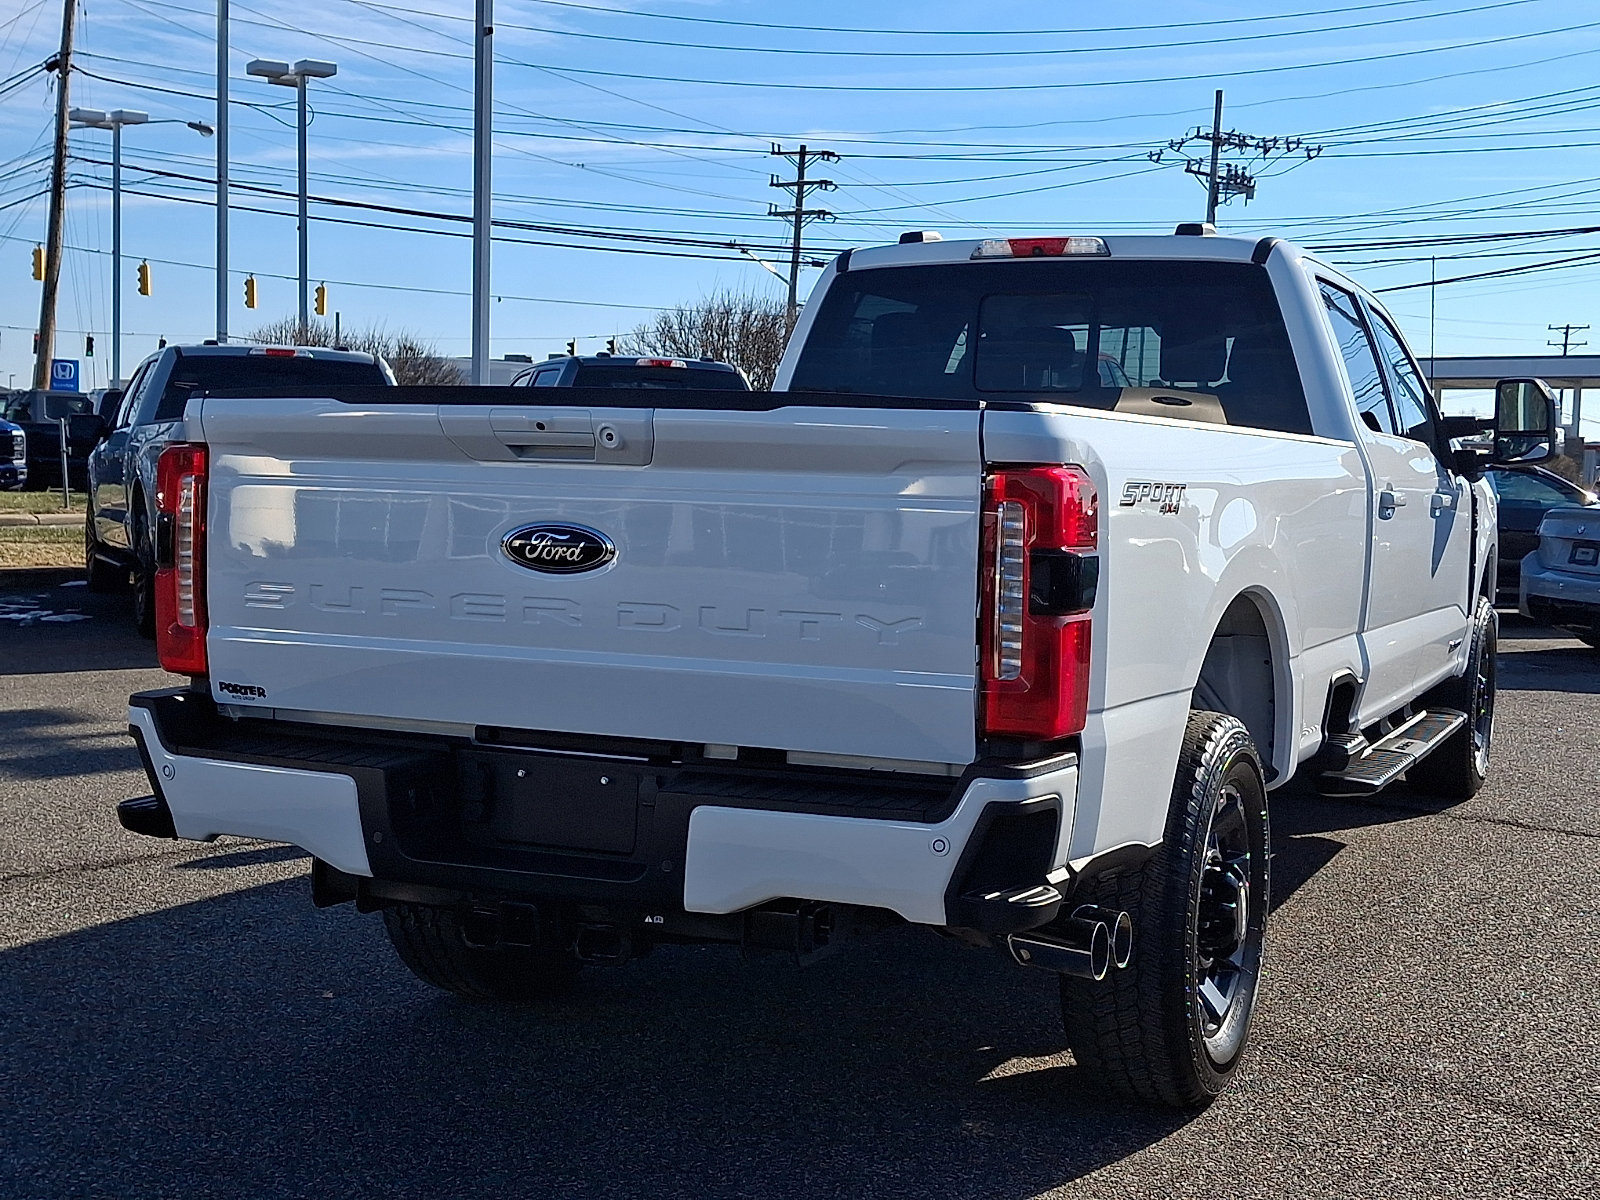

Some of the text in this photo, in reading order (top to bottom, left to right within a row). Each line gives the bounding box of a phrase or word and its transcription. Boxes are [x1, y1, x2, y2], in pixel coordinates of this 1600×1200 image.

[1119, 482, 1187, 506] SPORT
[525, 531, 586, 561] Ford
[244, 581, 923, 645] SUPER DUTY
[218, 681, 267, 698] PORTER
